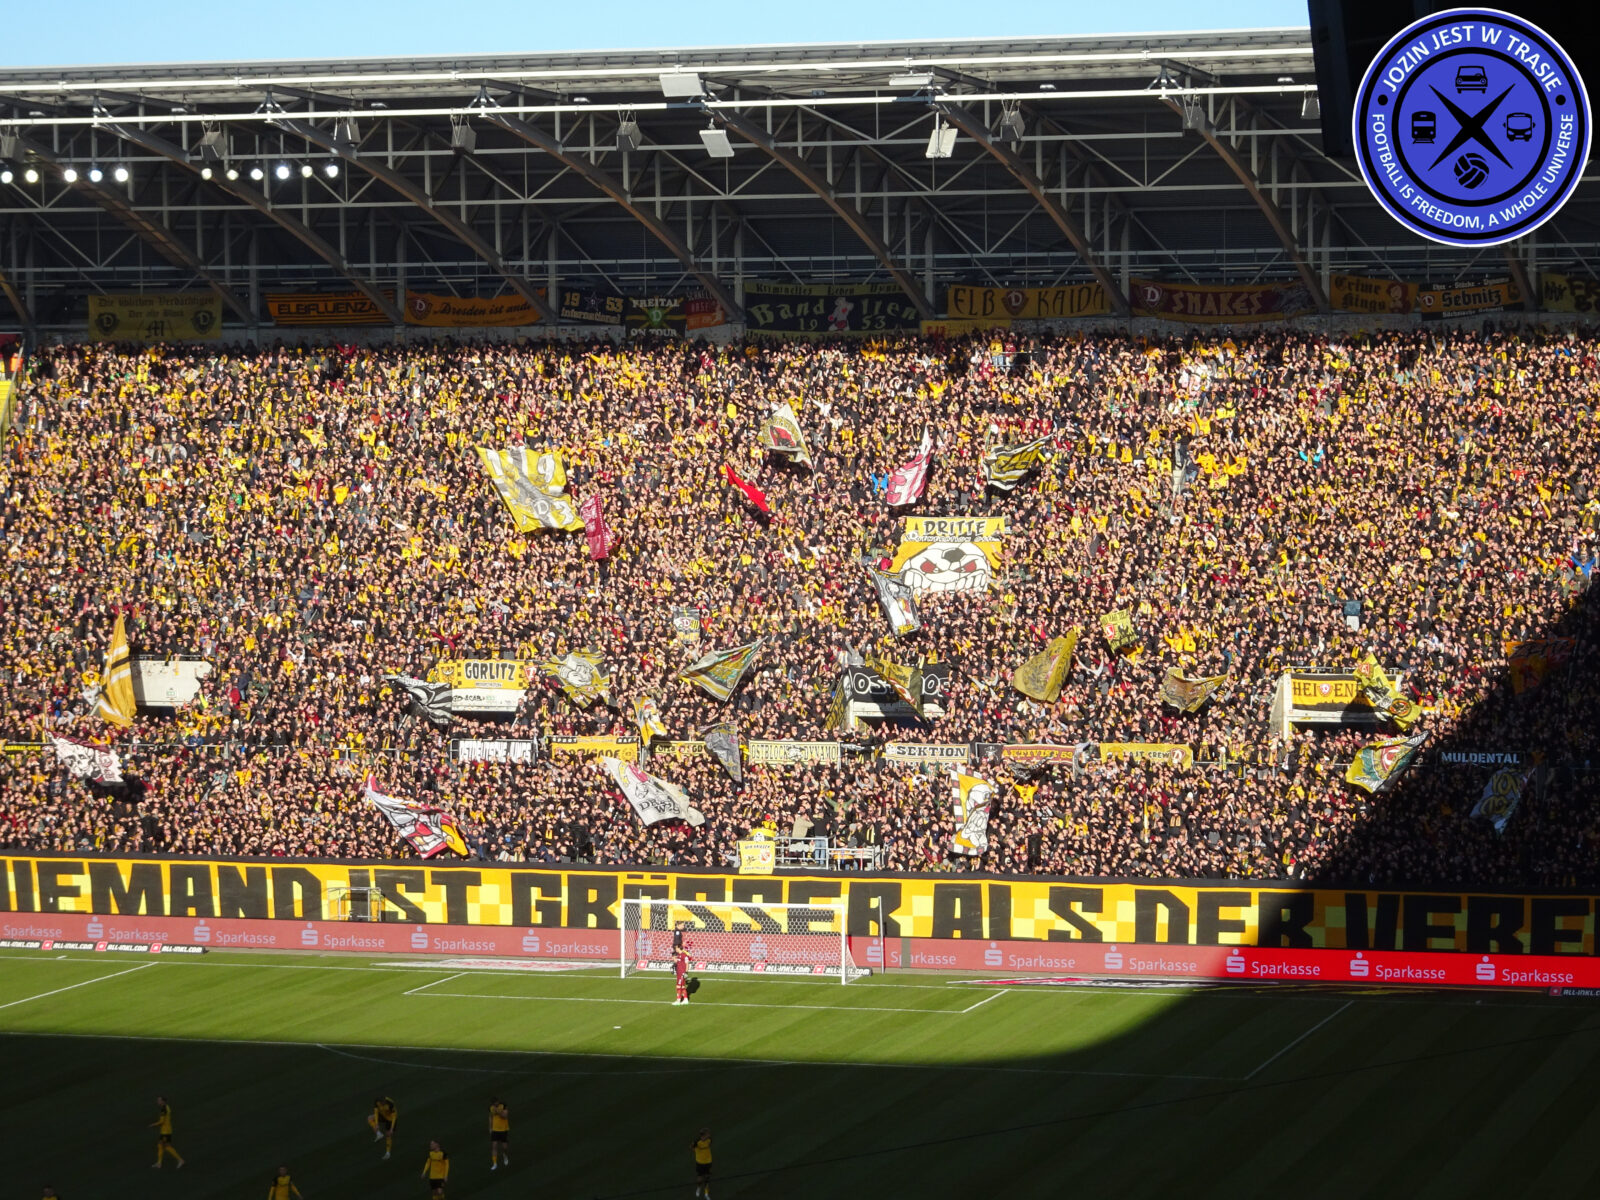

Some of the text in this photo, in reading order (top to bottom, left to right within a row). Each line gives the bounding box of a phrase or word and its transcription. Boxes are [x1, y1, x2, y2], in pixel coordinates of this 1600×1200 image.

[1335, 276, 1381, 295] Crime
[564, 292, 624, 312] 19 53
[632, 298, 681, 308] FREITAL
[954, 287, 995, 316] ELB
[1038, 285, 1105, 316] KAIDA
[1171, 291, 1262, 315] SNAKES
[1442, 288, 1502, 307] Sebnitz
[748, 298, 825, 327] Band
[630, 328, 677, 337] ON TOUR
[924, 520, 985, 536] DRITTE
[896, 745, 966, 757] SEKTION
[1441, 751, 1520, 764] MULDENTAL
[0, 860, 1600, 956] IEMAND IST GRÖSSER ALS DER VERE
[4, 925, 62, 939] Sparkasse
[109, 928, 168, 943] Sparkasse
[216, 931, 276, 946] Sparkasse
[324, 934, 385, 949] Sparkasse
[434, 937, 496, 953] Sparkasse
[546, 940, 609, 956] Sparkasse
[890, 950, 956, 966] Sarkasse
[1009, 954, 1076, 970] Sparkasse
[1129, 957, 1197, 972] Sparkasse
[1251, 961, 1321, 977] Sparkasse
[1376, 965, 1446, 981] Sparkasse
[1502, 968, 1574, 985] Sparkasse
